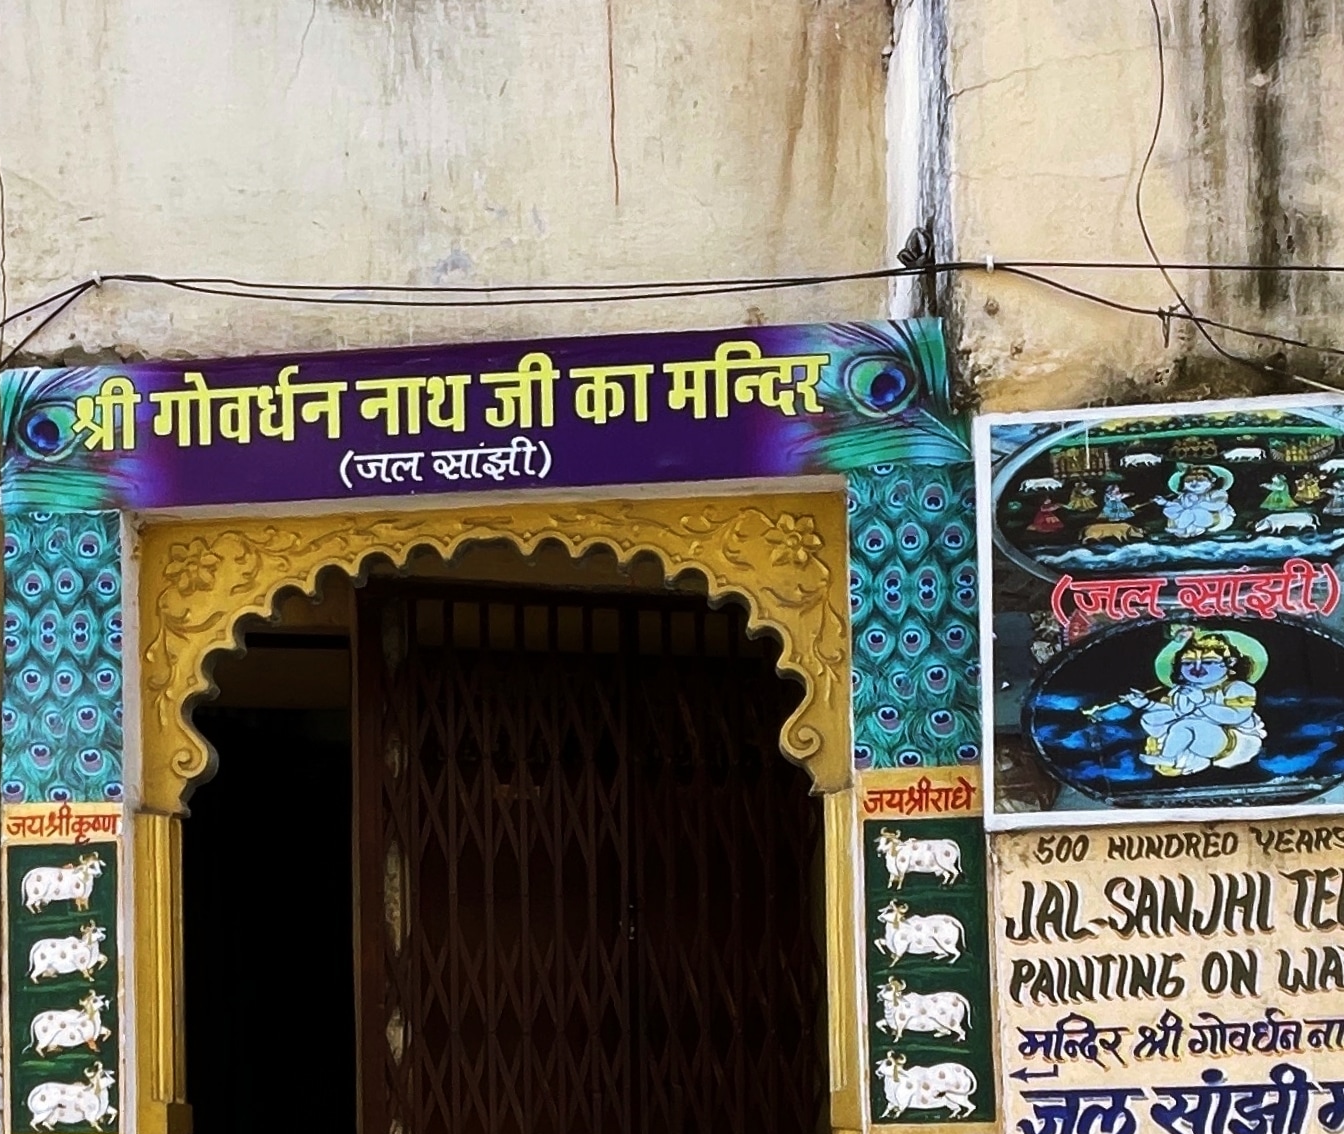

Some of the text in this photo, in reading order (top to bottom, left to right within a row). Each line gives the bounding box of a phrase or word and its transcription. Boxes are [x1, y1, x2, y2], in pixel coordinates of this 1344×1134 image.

[72, 340, 829, 451] श्री गोवर्धन नाथ जी का मन्दिर
[340, 436, 552, 489] (जल सांझी)
[1051, 573, 1168, 627] (जल
[1033, 834, 1090, 864] 500
[1108, 831, 1238, 861] HUNDRED
[1005, 871, 1275, 944] JAL-SANJHI
[1008, 952, 1186, 1005] PAINTING
[1201, 948, 1258, 997] ON
[1017, 1012, 1129, 1070] मन्दिर
[1133, 1008, 1184, 1059] श्री
[1188, 1011, 1304, 1059] गोवर्धन
